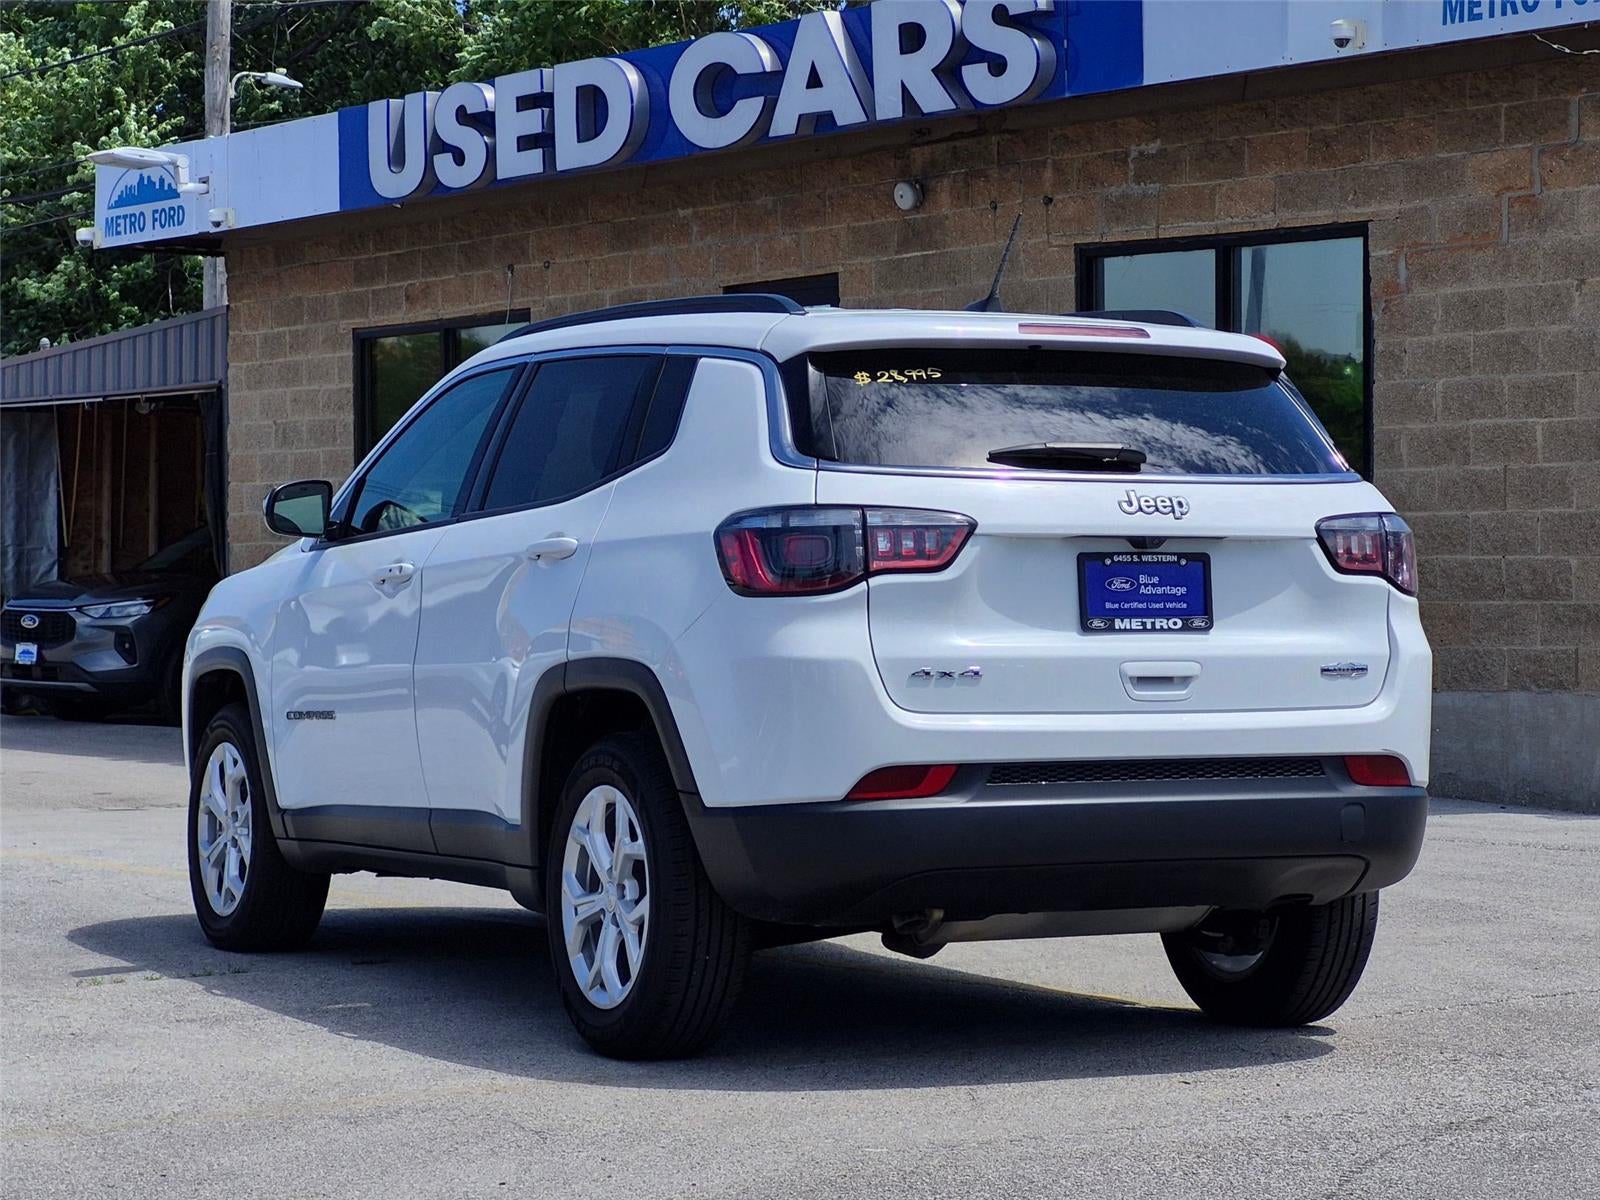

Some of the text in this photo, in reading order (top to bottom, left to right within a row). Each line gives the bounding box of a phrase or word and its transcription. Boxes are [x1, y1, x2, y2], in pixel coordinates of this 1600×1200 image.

[368, 0, 1050, 199] USED CARS
[104, 204, 186, 238] METRO FORD
[853, 367, 943, 387] $ 28,995
[1117, 489, 1191, 520] Jeep
[1113, 554, 1132, 562] 6455
[1141, 554, 1178, 562] WESTERN
[1111, 579, 1132, 589] Ford
[1139, 574, 1160, 584] Blue
[1139, 585, 1187, 596] Advantage
[1105, 601, 1188, 609] Blue Certified Used Vehicle
[1114, 618, 1183, 630] METRO
